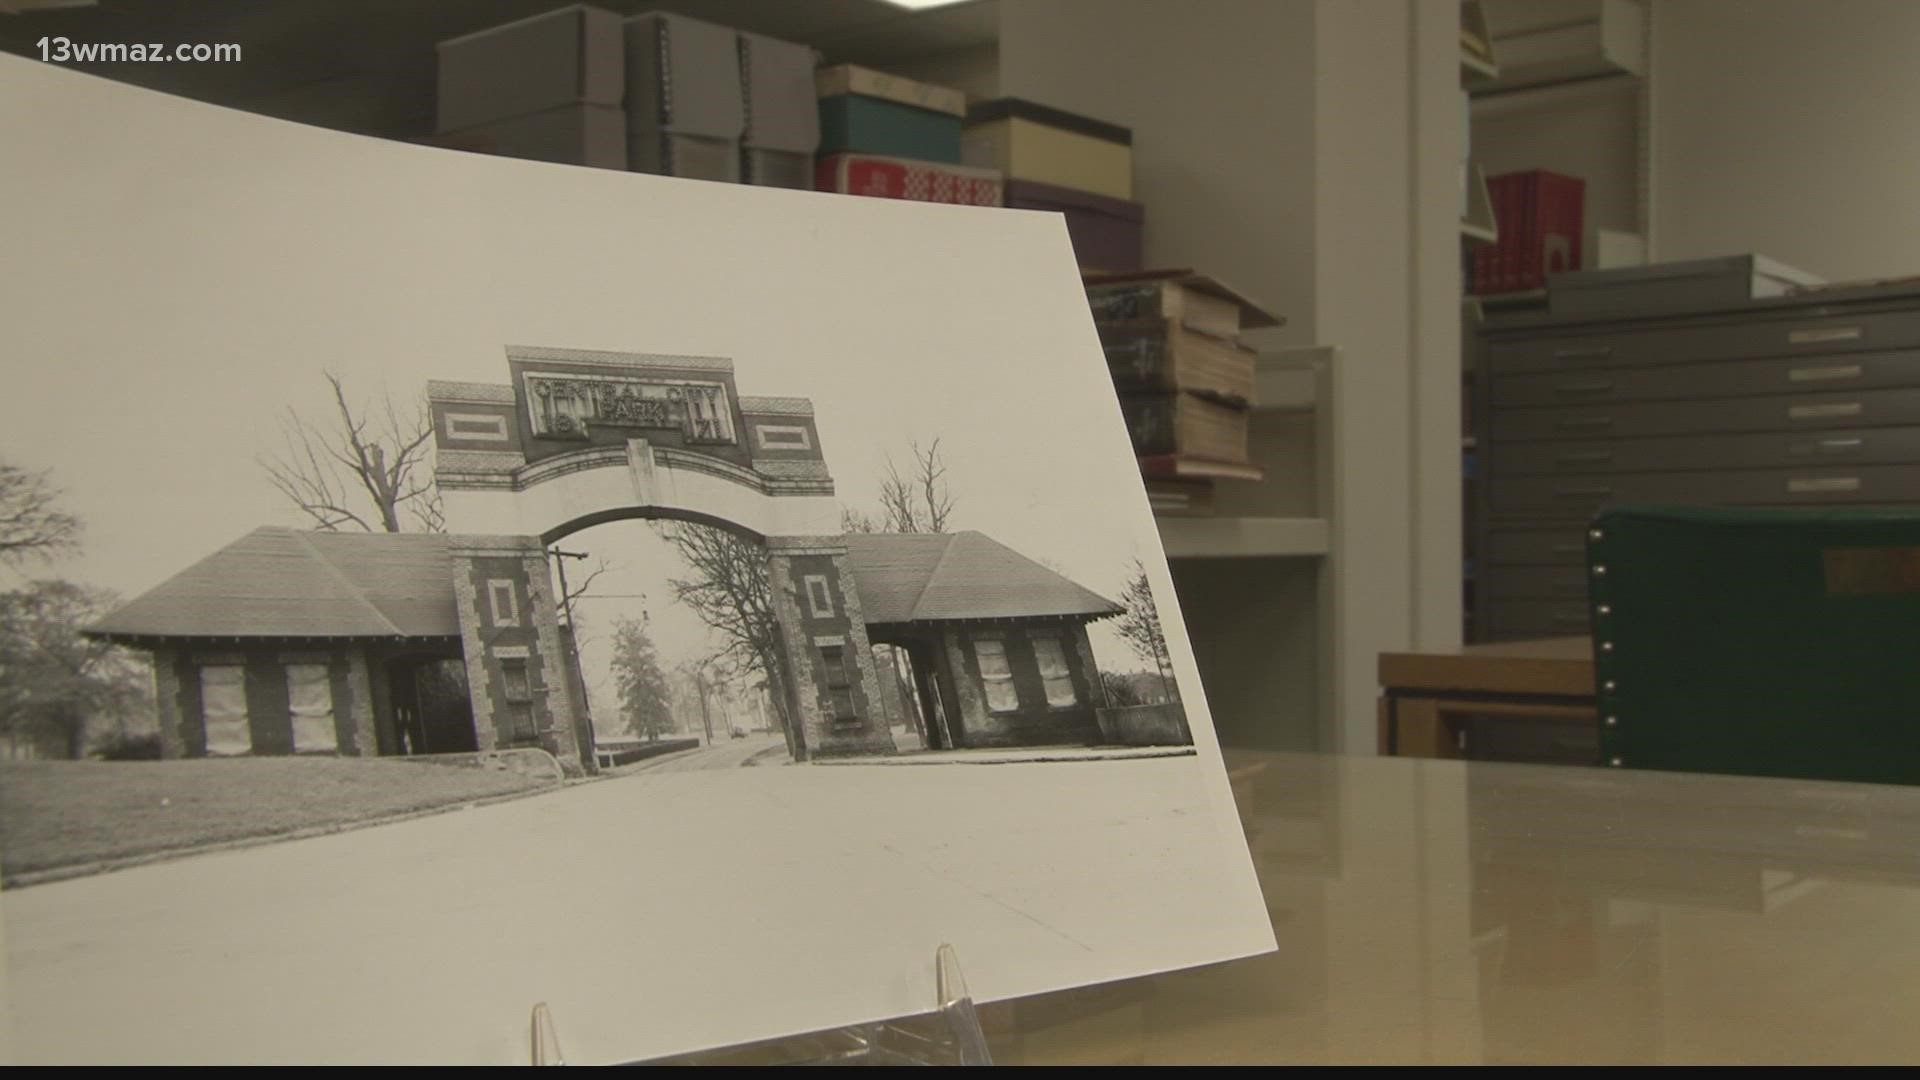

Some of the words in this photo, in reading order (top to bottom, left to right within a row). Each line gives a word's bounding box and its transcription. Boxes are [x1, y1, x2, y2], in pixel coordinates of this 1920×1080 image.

[535, 379, 644, 403] CENTRAL
[666, 386, 717, 404] CITY
[602, 399, 665, 421] PARK
